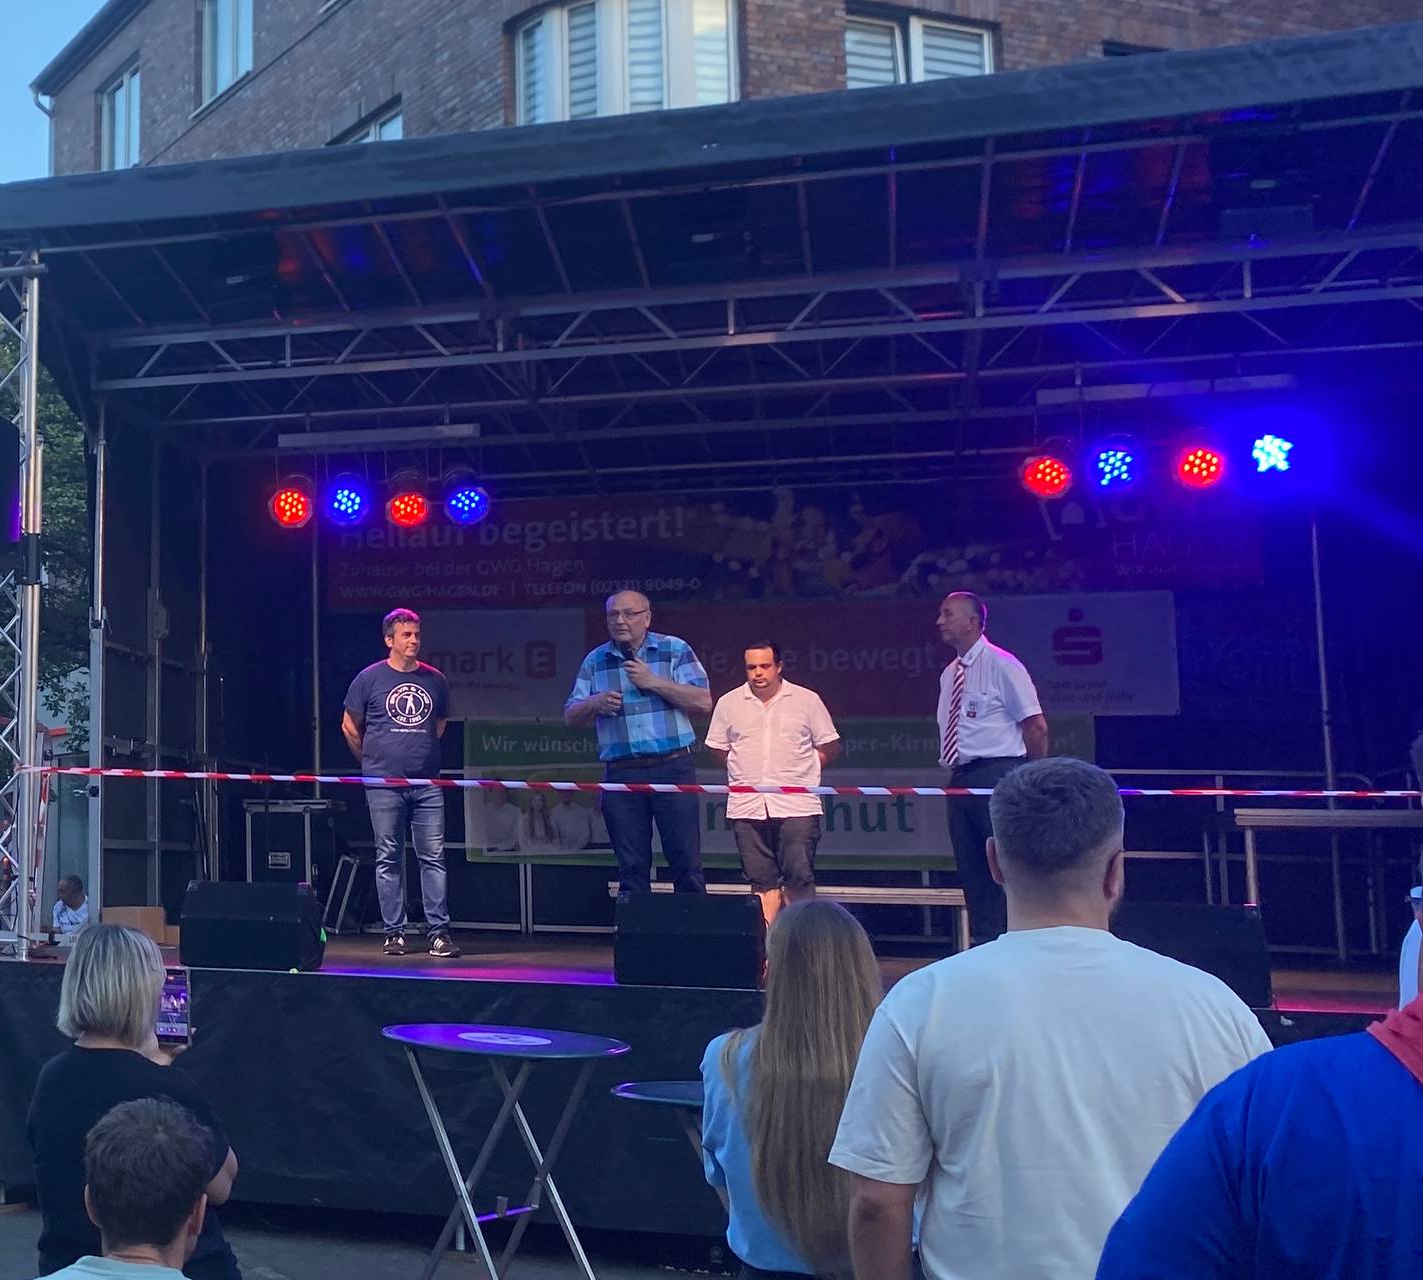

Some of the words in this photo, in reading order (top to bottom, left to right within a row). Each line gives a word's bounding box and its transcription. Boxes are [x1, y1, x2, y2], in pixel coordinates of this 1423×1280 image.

[479, 507, 685, 553] begeistert!
[526, 557, 584, 577] Hagen
[481, 735, 518, 752] Wir
[523, 735, 599, 753] wünsch
